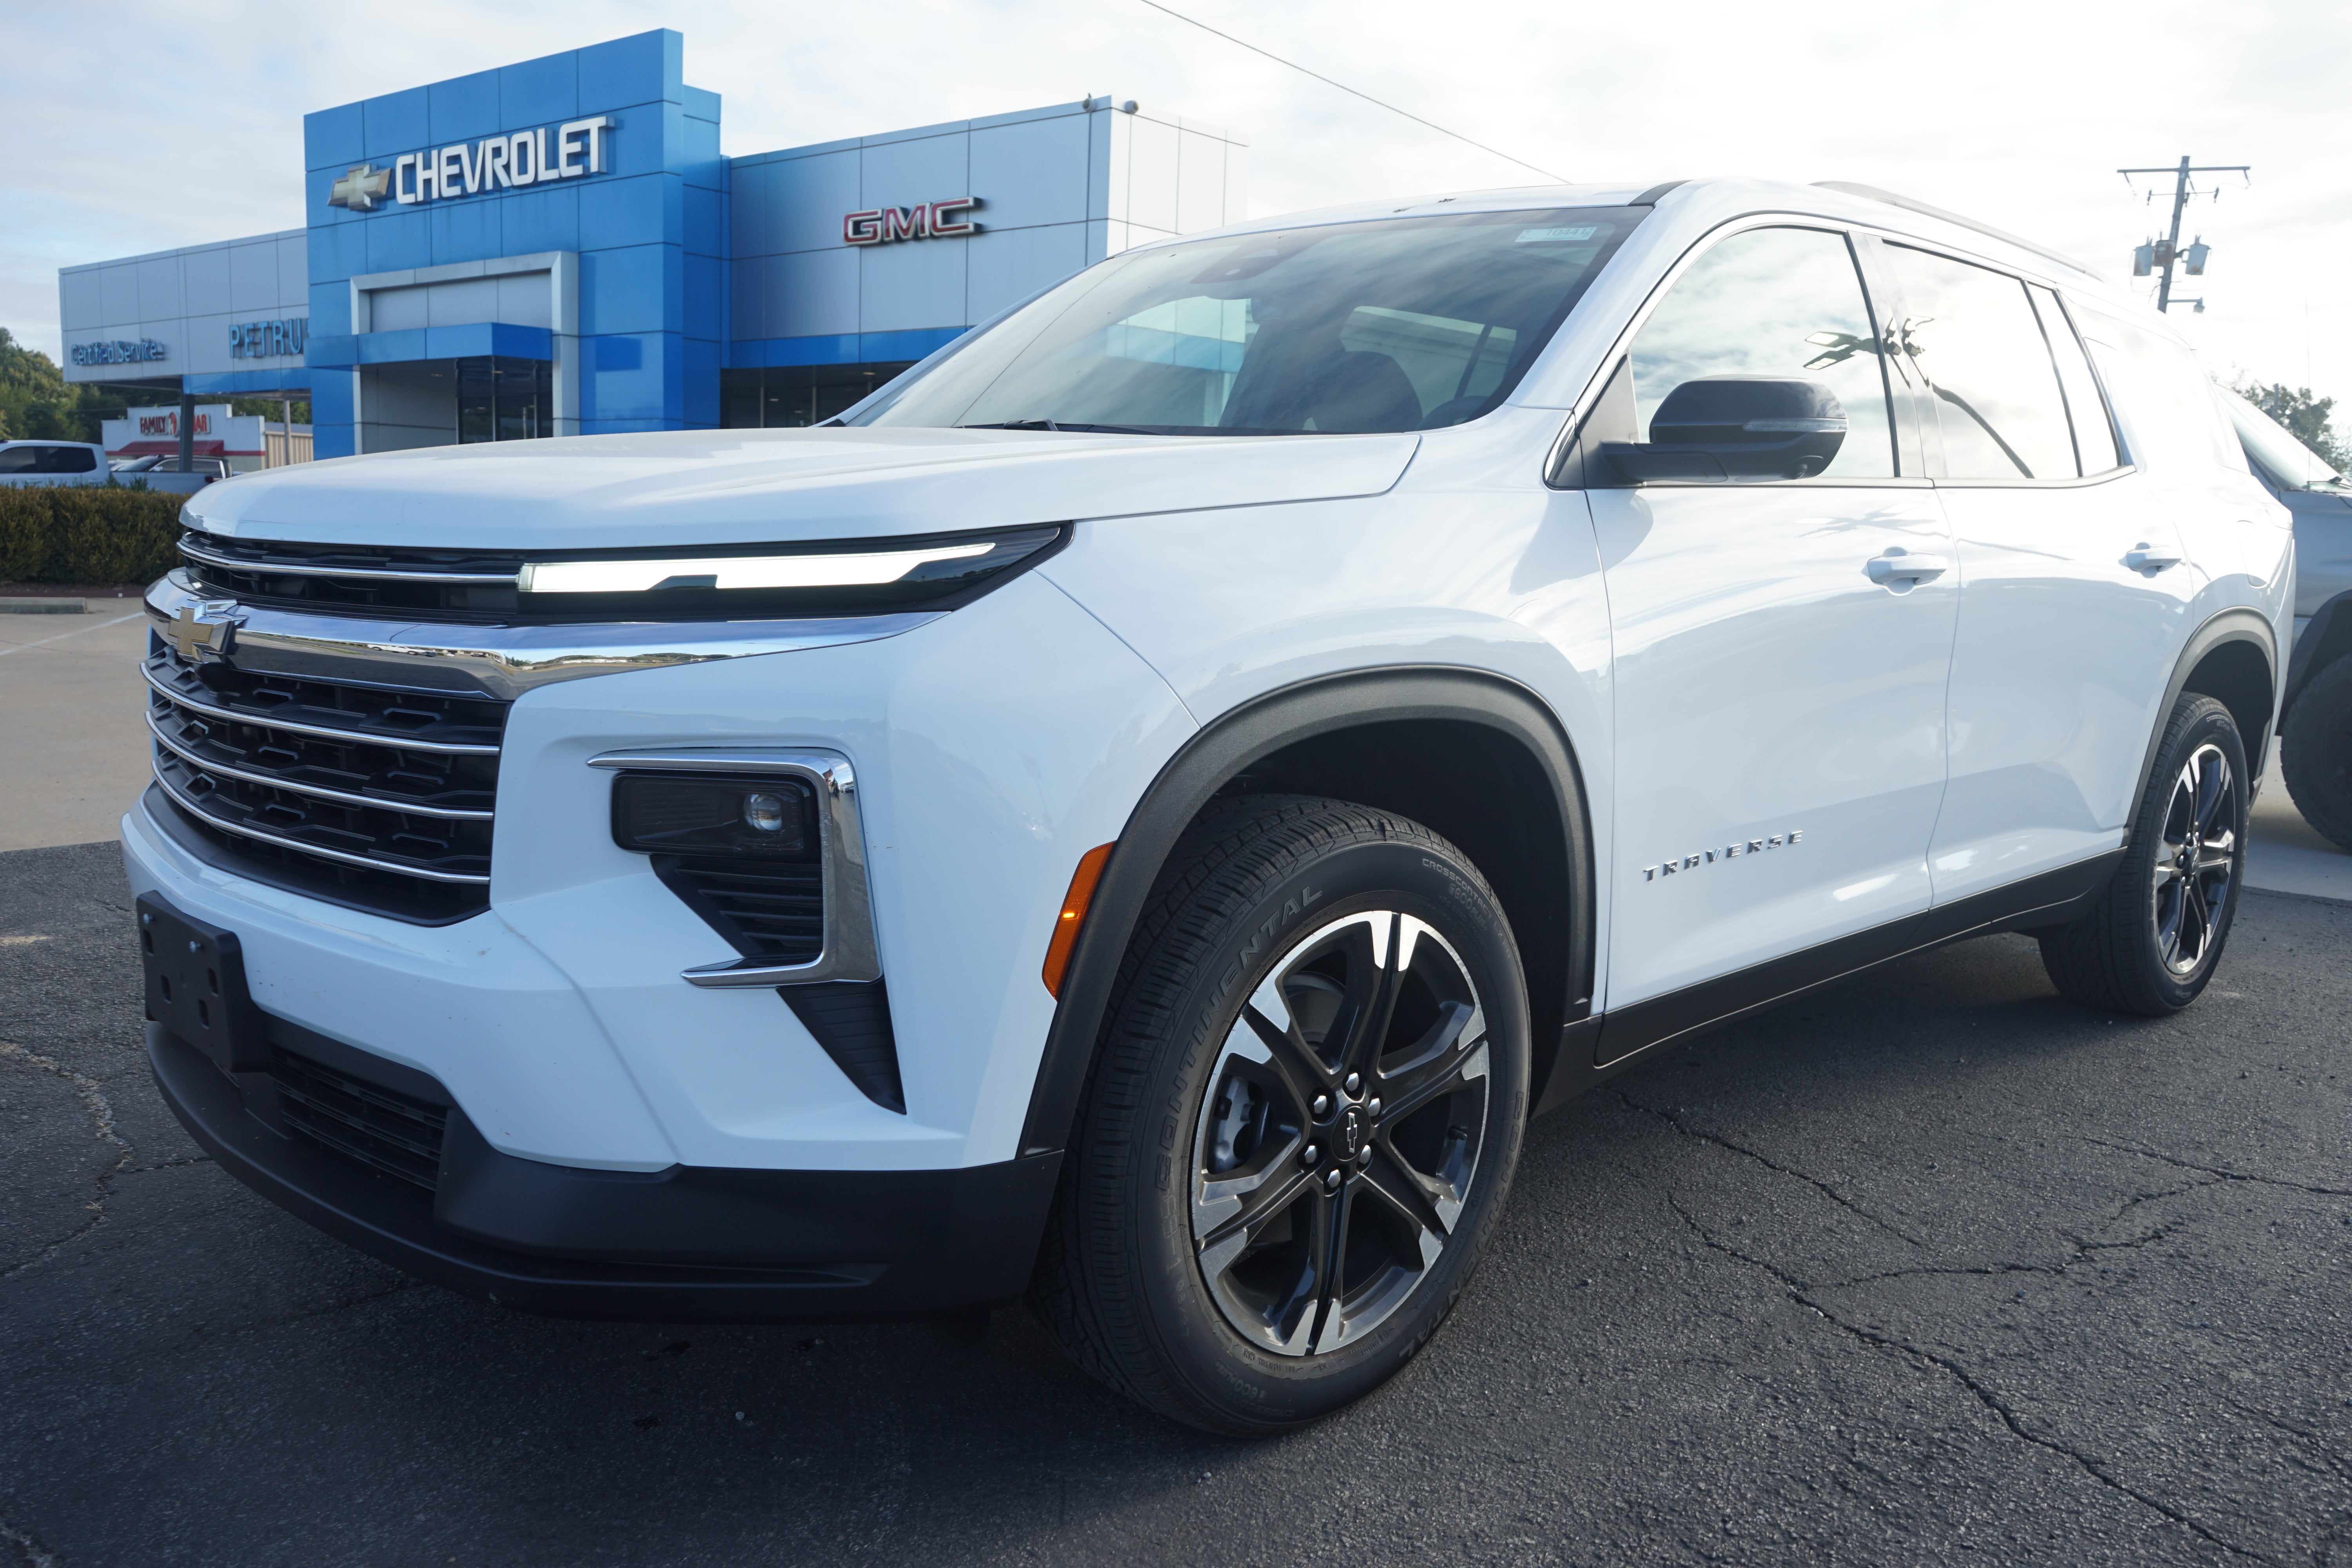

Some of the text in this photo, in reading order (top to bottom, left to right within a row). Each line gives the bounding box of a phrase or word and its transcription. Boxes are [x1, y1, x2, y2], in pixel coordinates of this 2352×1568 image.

[395, 116, 615, 204] CHEVROLET
[843, 196, 982, 245] GMC
[71, 339, 160, 365] Certified Service
[229, 317, 309, 358] PETRU
[140, 416, 167, 434] FAMILY
[1643, 830, 1803, 881] TRAVERSE
[1422, 858, 1493, 919] CROSSCONTACT
[1155, 885, 1323, 1191] CONTINENTAL
